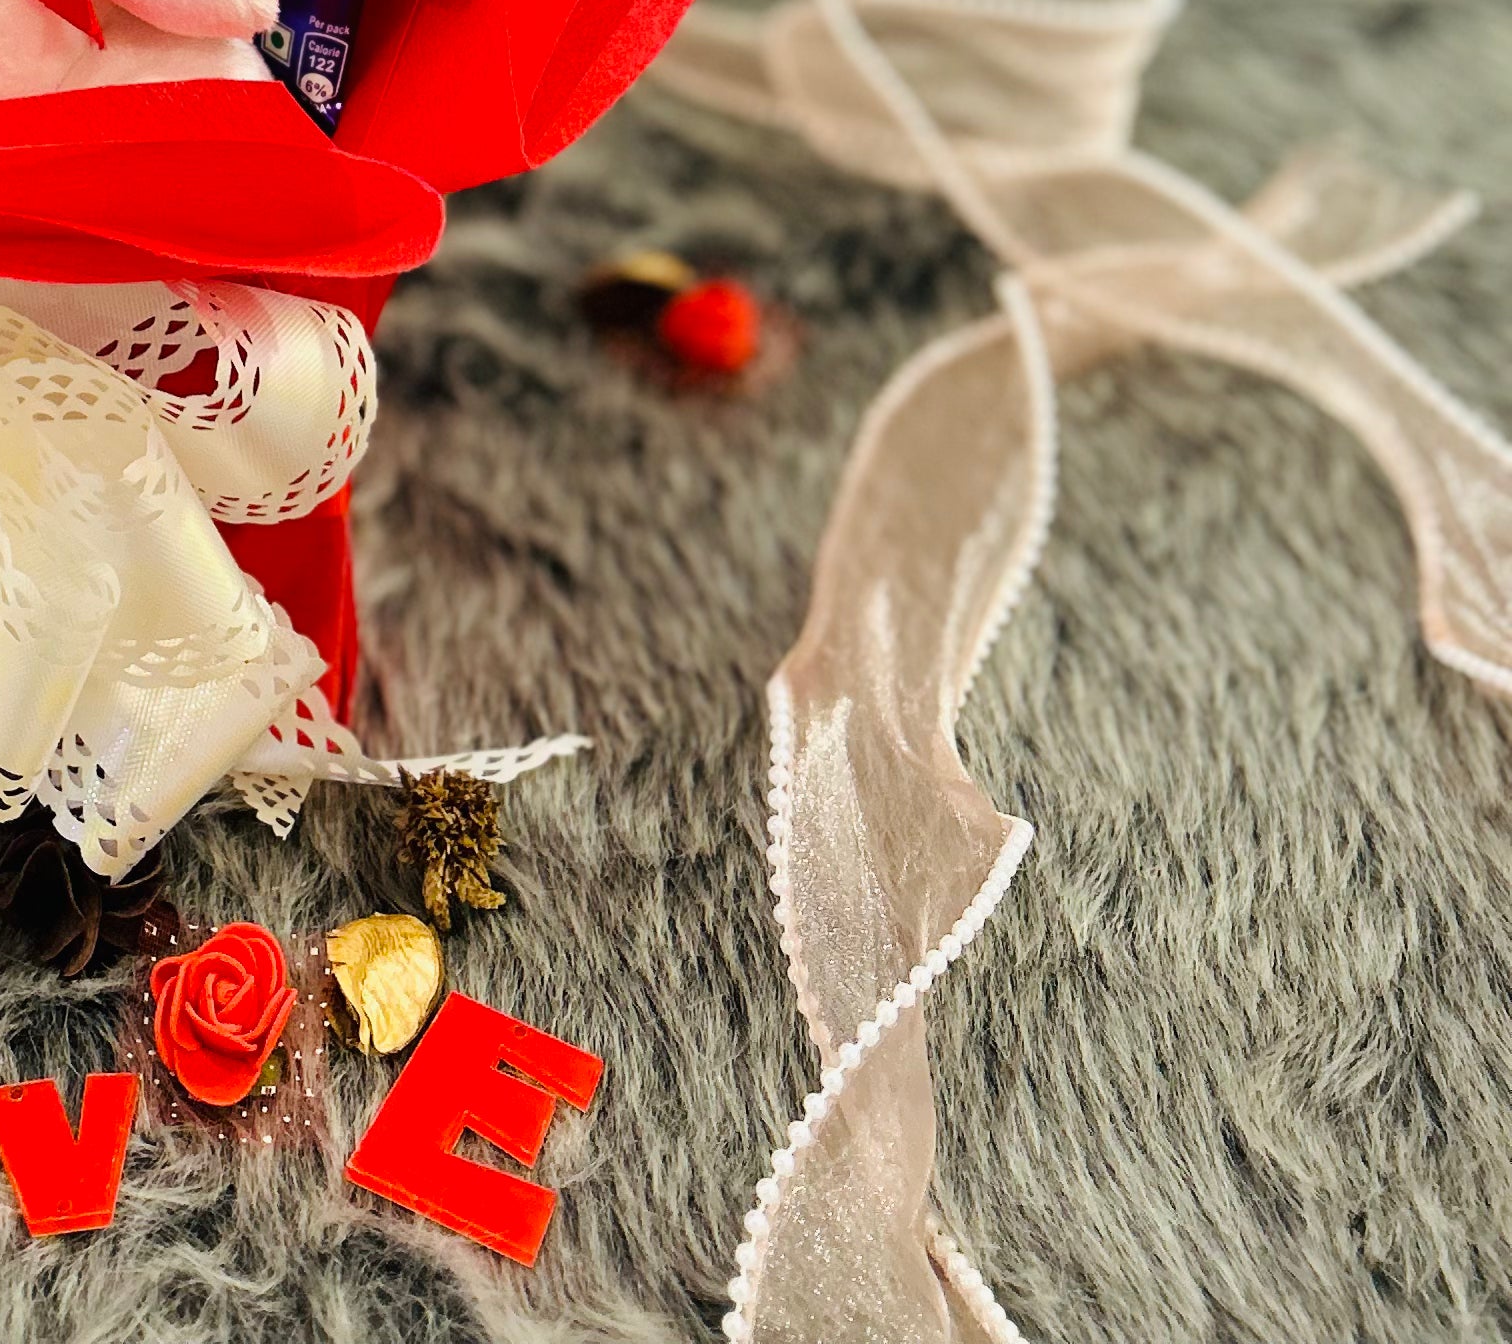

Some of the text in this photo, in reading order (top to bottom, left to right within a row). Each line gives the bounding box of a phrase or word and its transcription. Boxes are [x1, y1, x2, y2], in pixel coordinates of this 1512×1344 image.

[308, 15, 350, 36] Per pack
[308, 39, 341, 59] Calorie
[308, 54, 335, 73] 122
[305, 79, 327, 98] 6%
